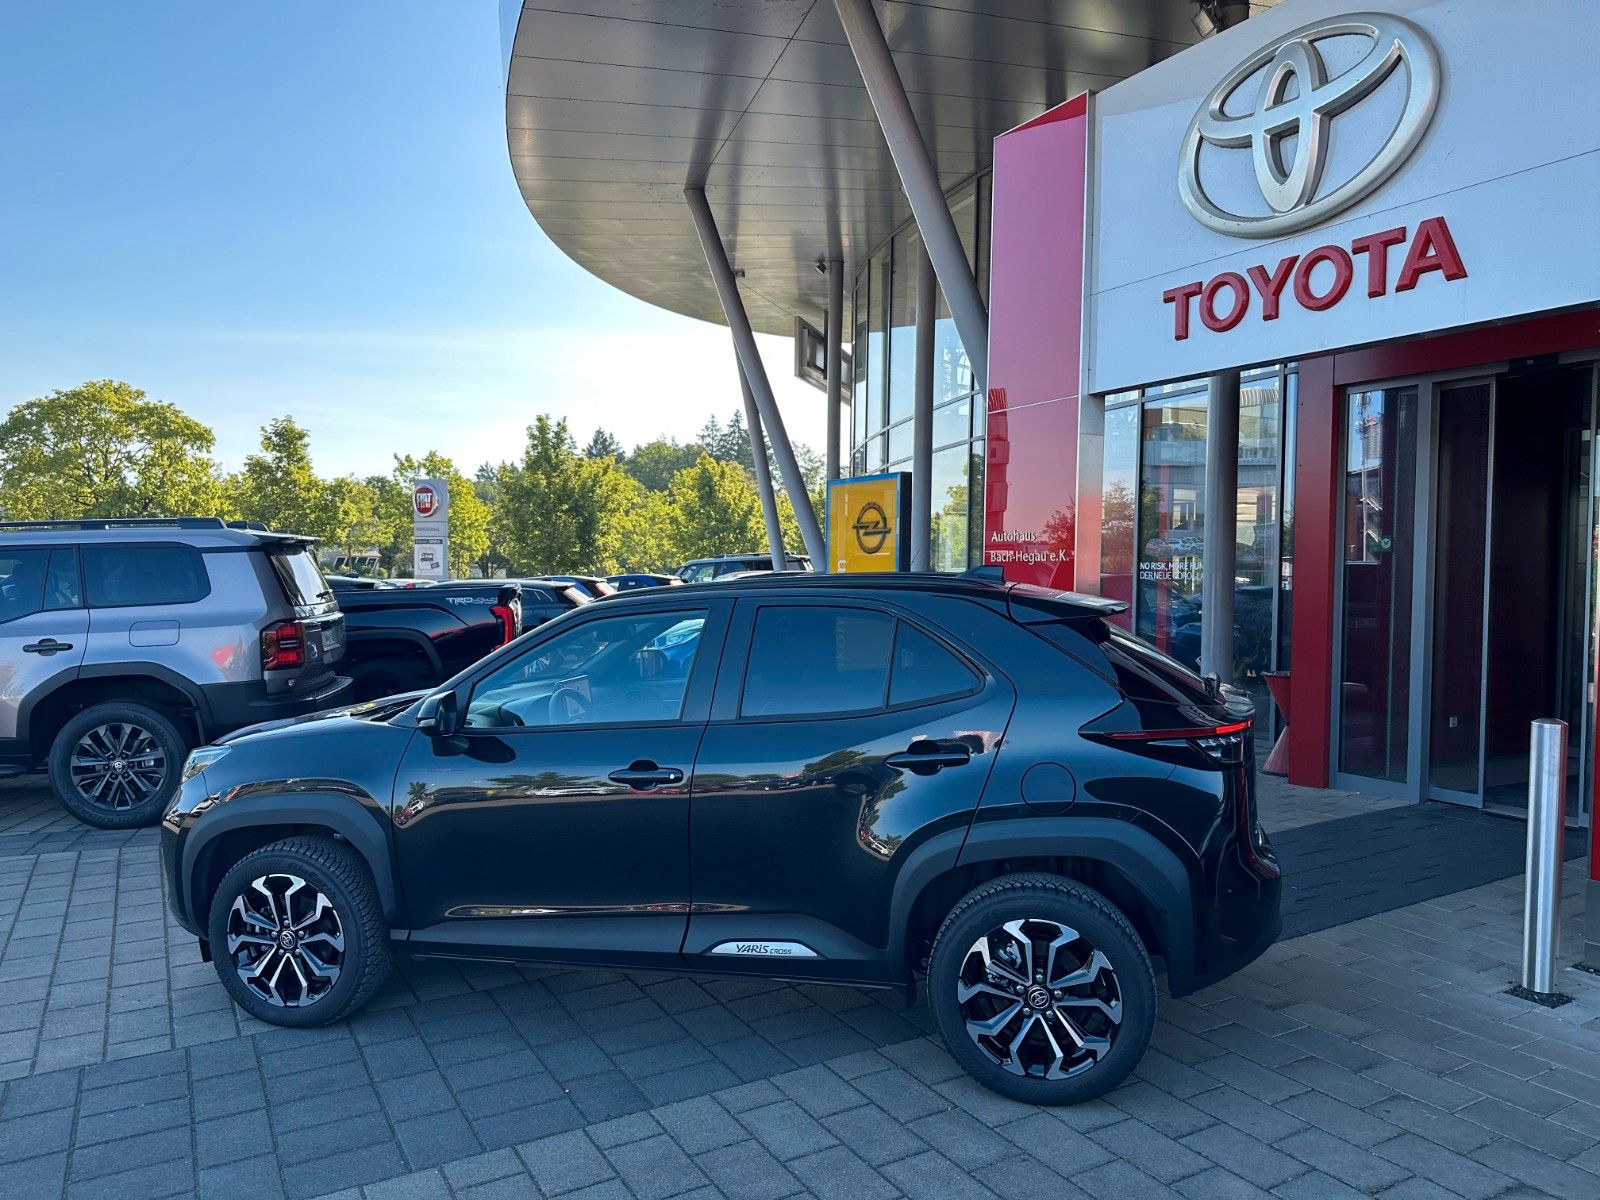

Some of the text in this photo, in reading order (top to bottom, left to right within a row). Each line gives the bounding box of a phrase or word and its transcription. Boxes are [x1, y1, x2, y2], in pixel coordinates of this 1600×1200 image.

[1163, 216, 1468, 341] TOYOTA
[991, 530, 1036, 542] Autohaus
[990, 549, 1069, 565] Bach-Hegau e.K.
[1140, 562, 1150, 570] NO
[1151, 562, 1168, 572] RISK,
[1169, 562, 1188, 570] MORE
[1140, 572, 1153, 580] DER
[1154, 572, 1171, 580] NEUE
